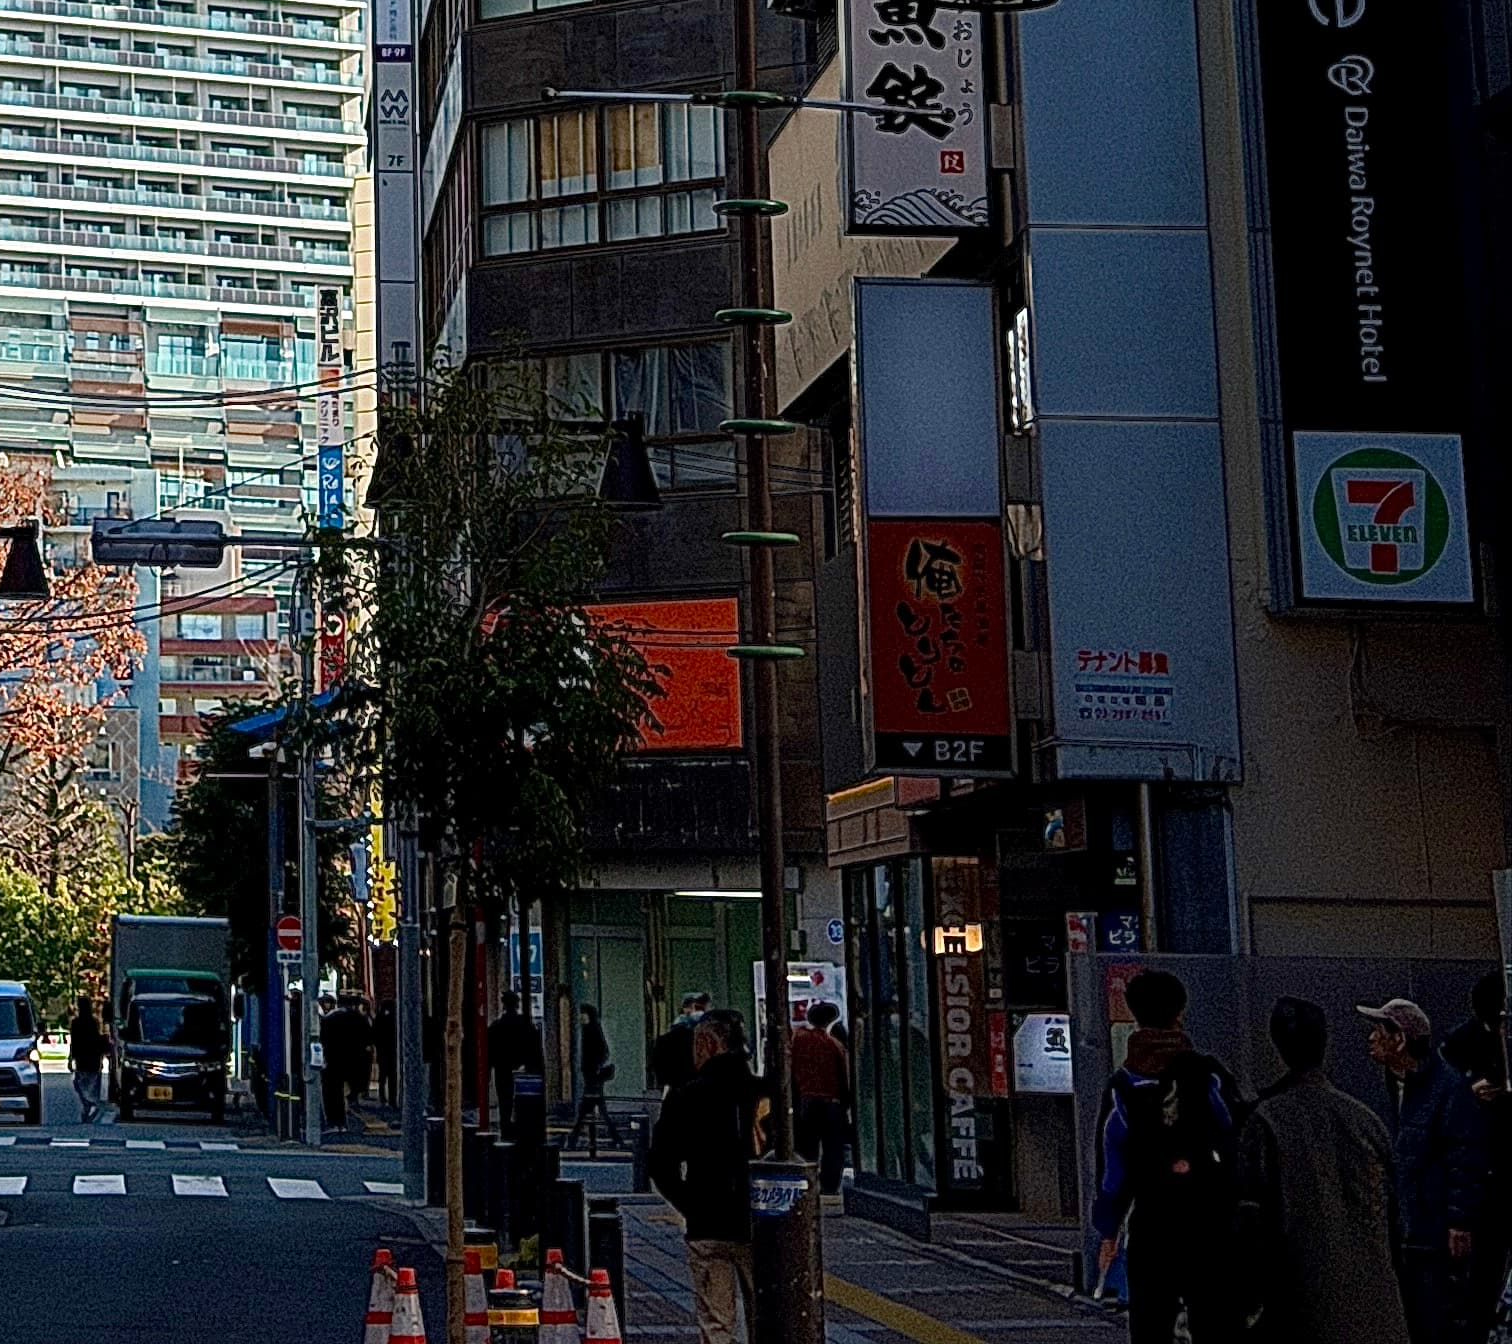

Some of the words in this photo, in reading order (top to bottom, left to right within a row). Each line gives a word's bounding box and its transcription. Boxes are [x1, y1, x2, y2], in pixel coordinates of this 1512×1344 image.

[952, 19, 974, 126] おじょう
[388, 154, 404, 167] 7F
[1343, 105, 1370, 191] Daiwa
[1347, 196, 1379, 297] Roynet
[1357, 304, 1388, 385] Hotel
[934, 739, 985, 762] B2F
